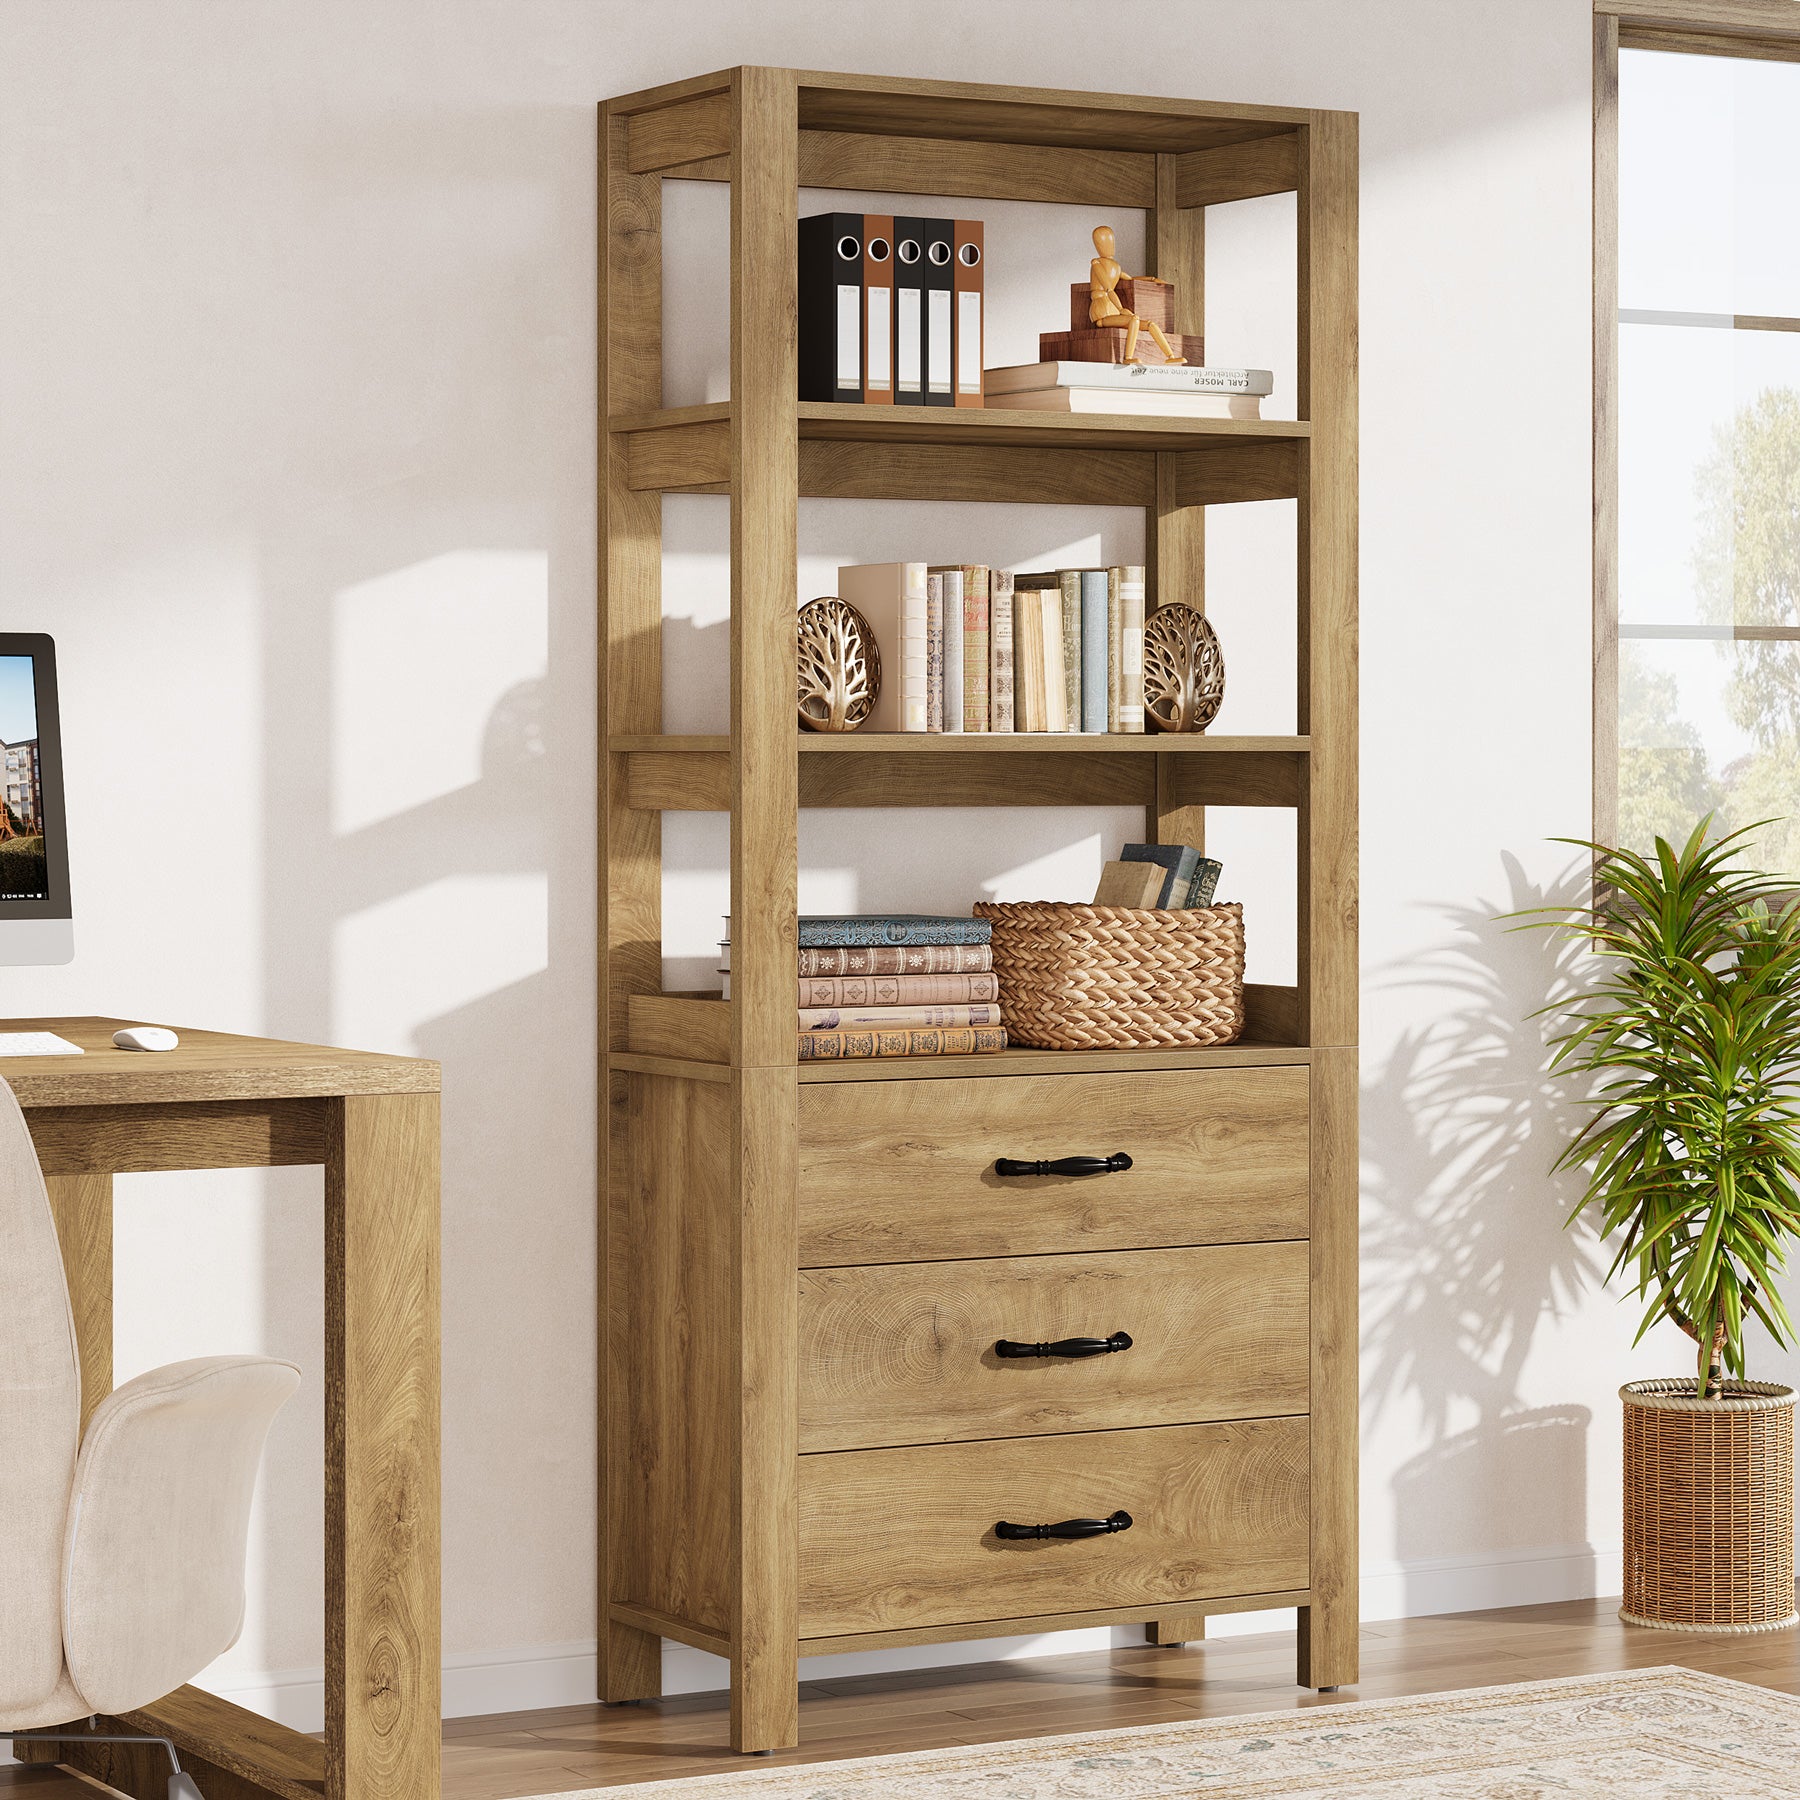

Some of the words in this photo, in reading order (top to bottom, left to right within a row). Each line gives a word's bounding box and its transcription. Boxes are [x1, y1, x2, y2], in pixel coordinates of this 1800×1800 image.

[1190, 369, 1202, 378] für
[1203, 370, 1250, 379] Architektur
[1194, 377, 1224, 386] MOSER
[1227, 378, 1249, 387] CARL
